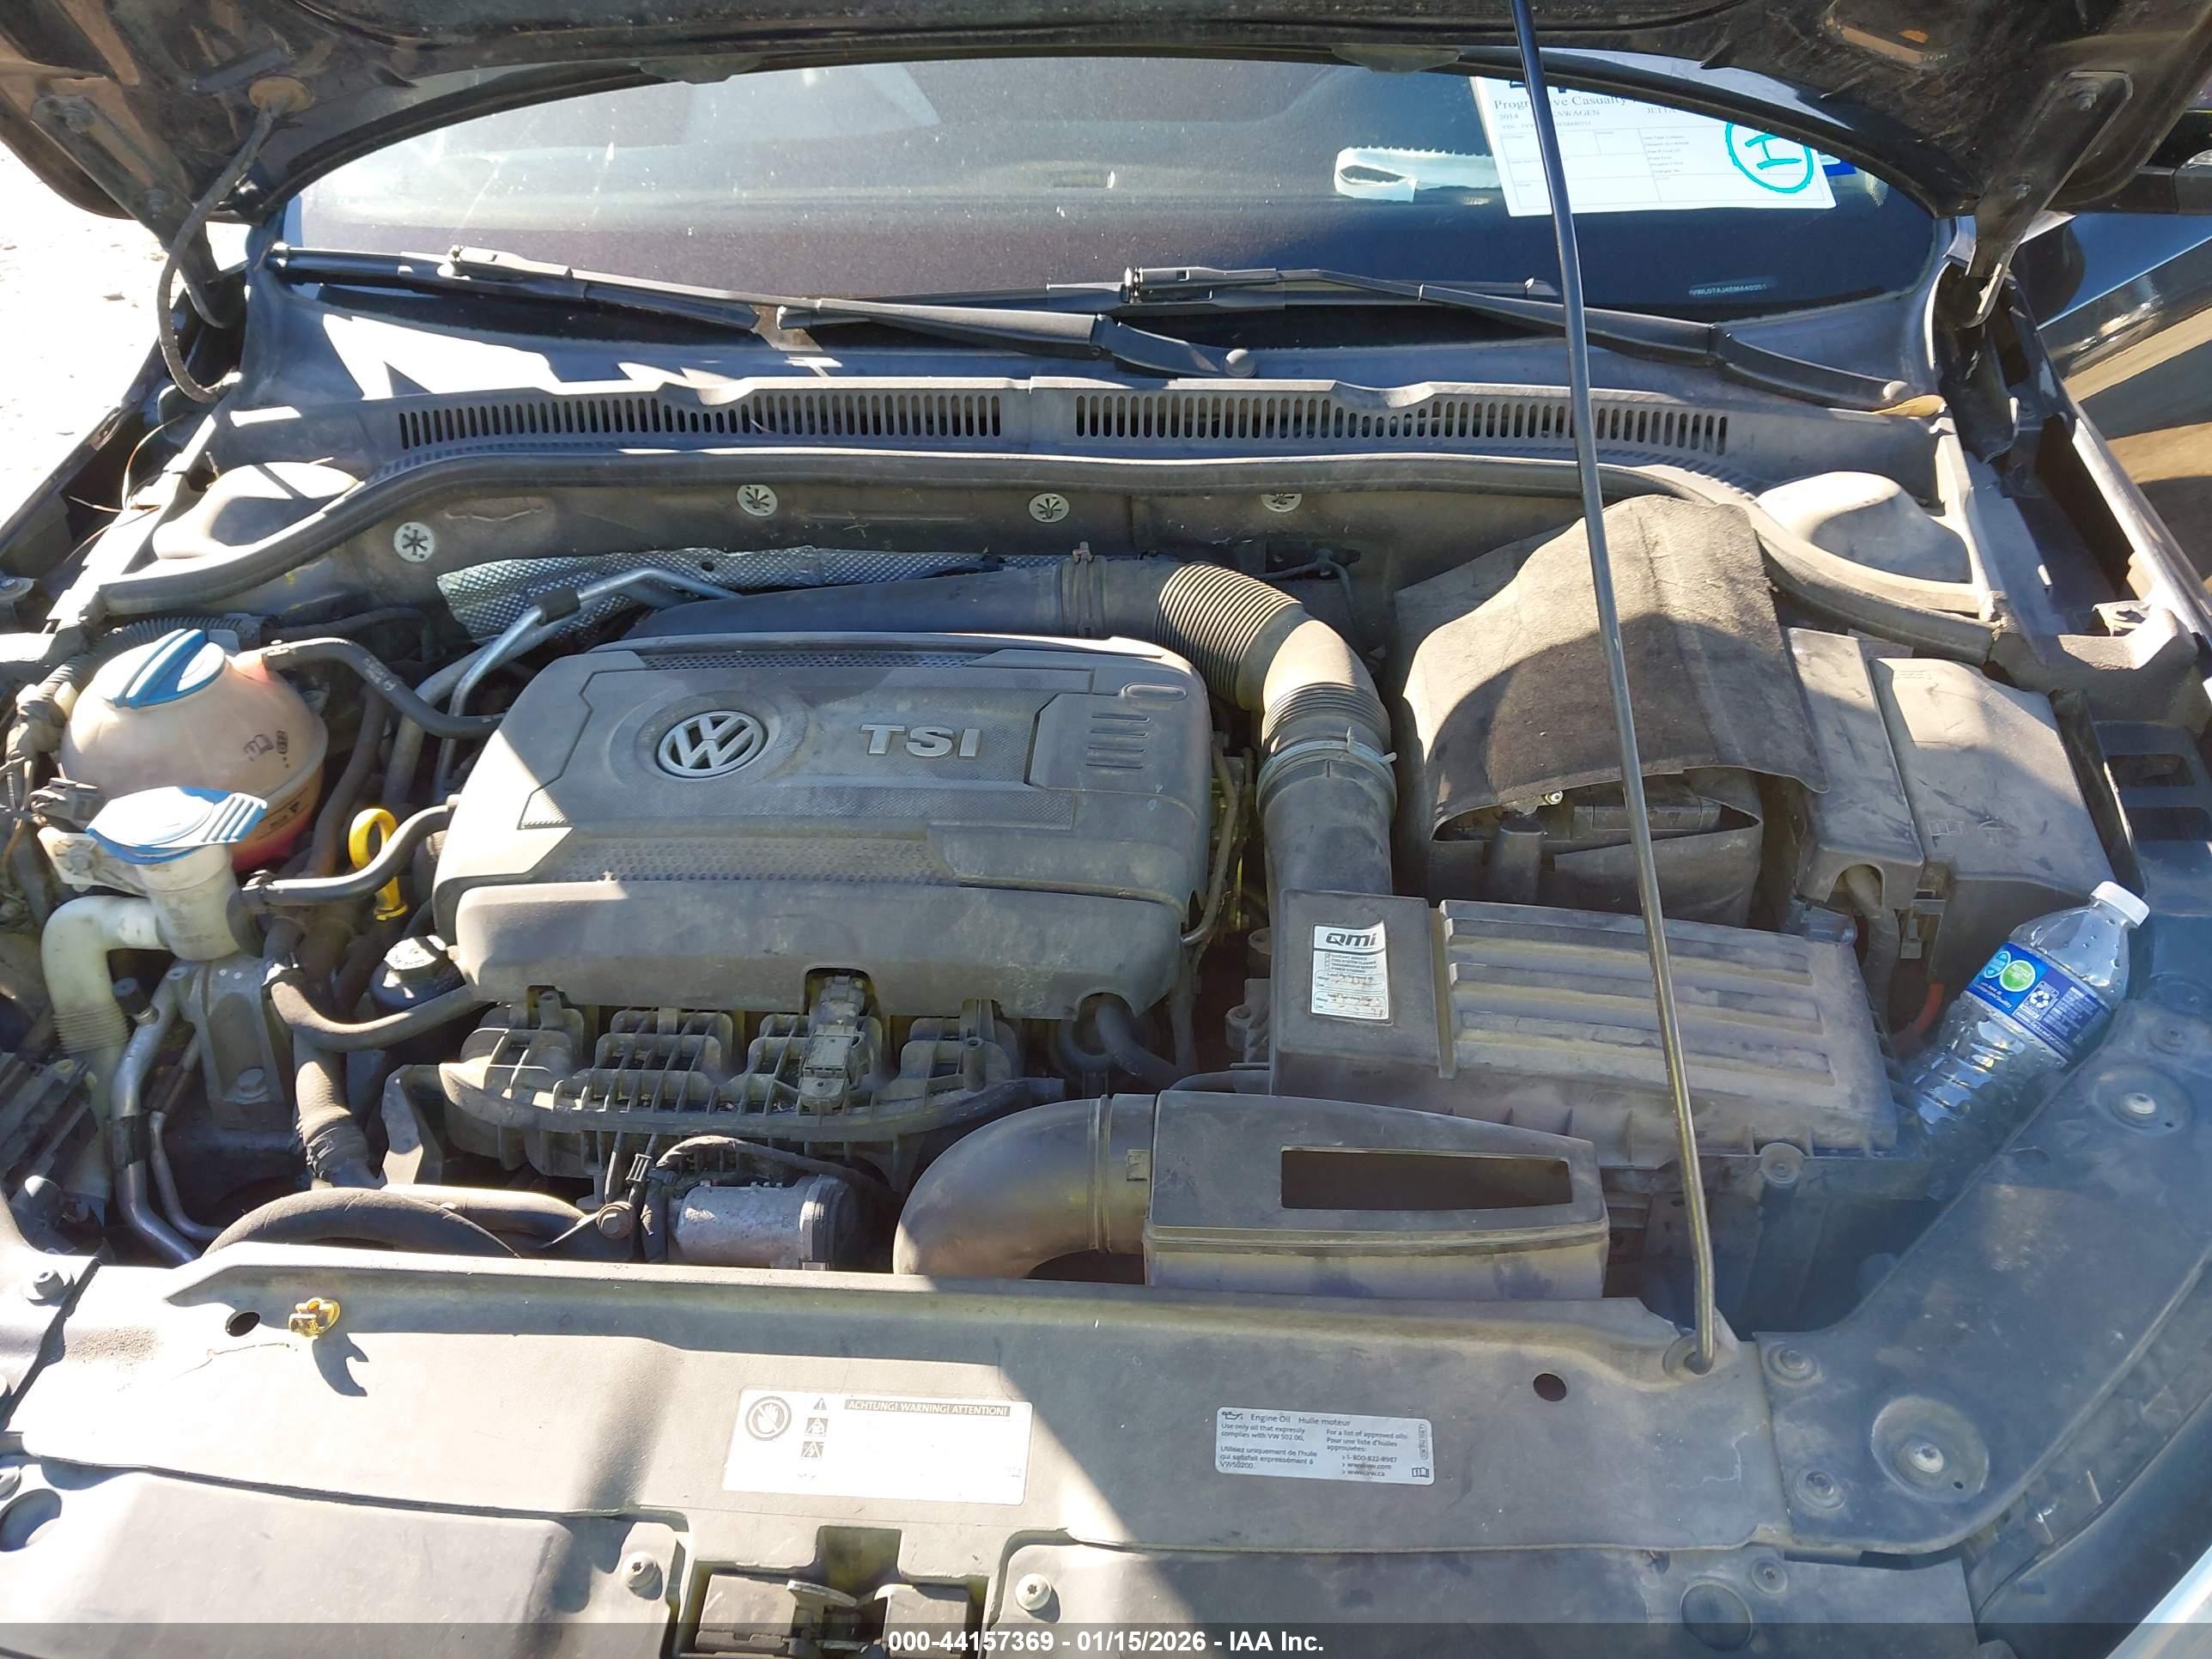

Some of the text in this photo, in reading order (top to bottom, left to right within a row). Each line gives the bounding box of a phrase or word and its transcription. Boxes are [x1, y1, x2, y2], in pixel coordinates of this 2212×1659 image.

[1494, 96, 1568, 111] Progrve
[860, 724, 981, 757] TSI
[848, 1400, 1008, 1416] ACHTUNG! WARNING! ATTENTION!
[1251, 1414, 1278, 1424] Engine
[1274, 1426, 1305, 1435] expressly
[1246, 1447, 1286, 1455] uniquement
[1260, 1456, 1307, 1465] expressément
